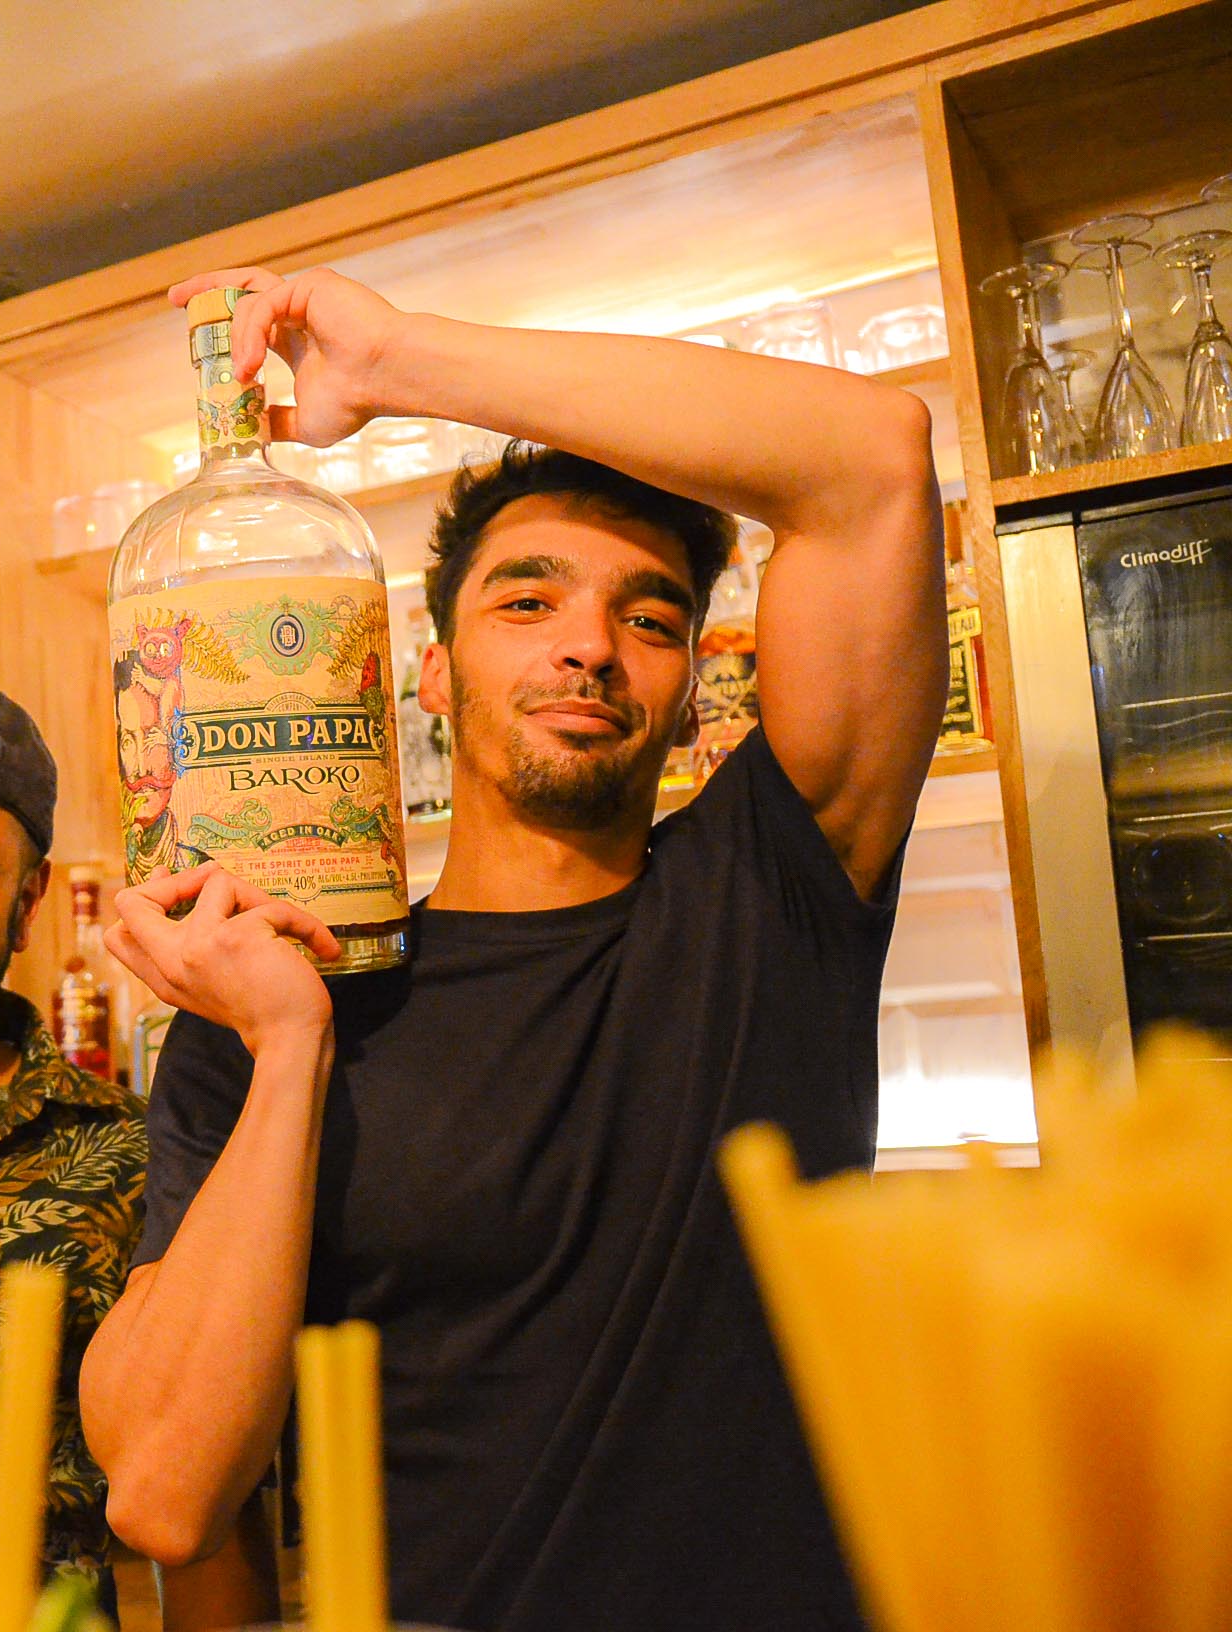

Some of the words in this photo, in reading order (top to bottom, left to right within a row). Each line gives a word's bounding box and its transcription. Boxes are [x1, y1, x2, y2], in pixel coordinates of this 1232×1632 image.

[1120, 539, 1211, 568] Climadiff
[202, 720, 278, 753] DON
[288, 718, 369, 746] PAPA
[255, 756, 296, 764] SINGLE
[229, 765, 360, 794] BAROKO
[263, 827, 295, 846] AGED
[299, 825, 313, 834] IN
[316, 826, 340, 841] OAK
[248, 862, 267, 870] THE
[269, 859, 302, 869] SPIRIT
[305, 858, 316, 867] OF
[319, 857, 337, 866] DON
[340, 856, 361, 865] PAPA
[262, 868, 291, 877] LIVES
[293, 867, 308, 875] ON
[324, 865, 336, 873] US
[339, 864, 354, 872] ALL
[272, 876, 293, 886] DRINK
[293, 875, 317, 890] 40%
